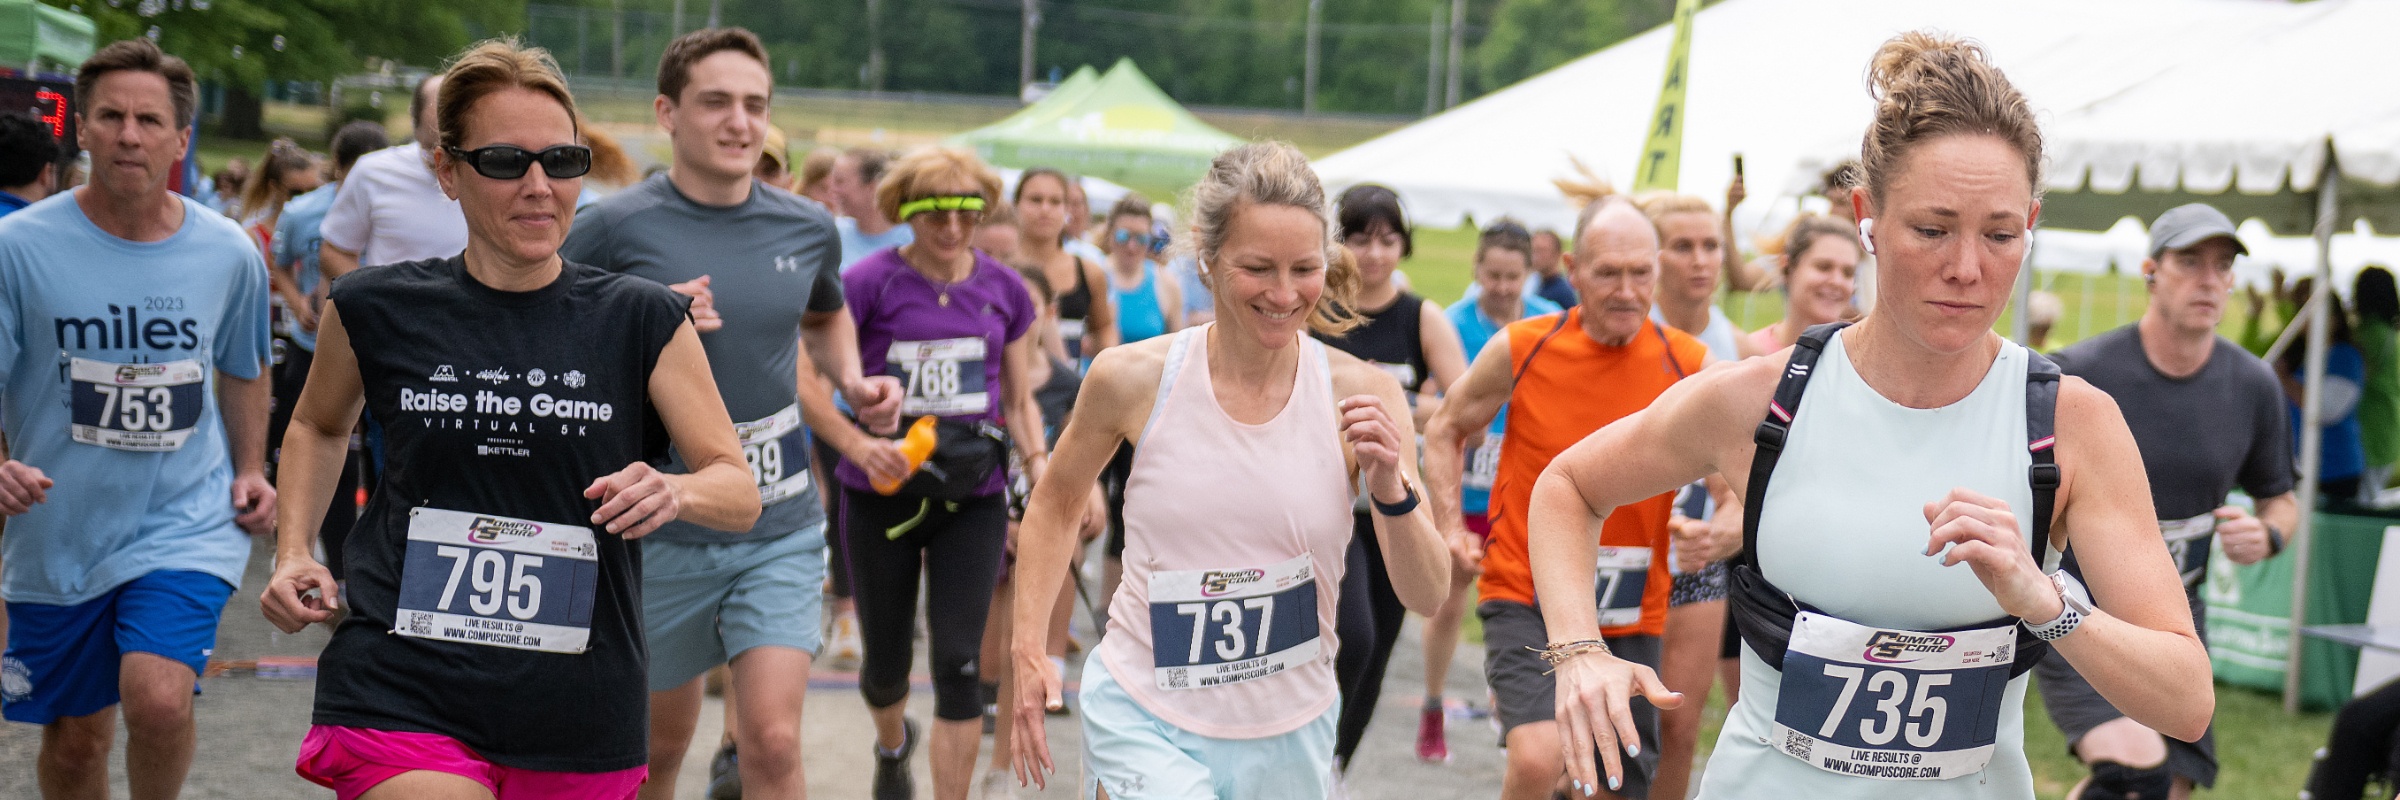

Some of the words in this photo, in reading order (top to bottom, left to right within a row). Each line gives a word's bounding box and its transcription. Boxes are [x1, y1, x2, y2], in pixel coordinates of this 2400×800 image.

[144, 296, 184, 311] 2023
[54, 303, 198, 350] miles
[901, 359, 960, 398] 768
[94, 383, 173, 432] 753
[400, 387, 468, 413] Raise
[475, 389, 522, 416] the
[530, 392, 613, 422] Game
[423, 417, 536, 434] VIRTUAL
[488, 446, 530, 458] KETTLER
[436, 544, 544, 620] 795
[464, 618, 481, 628] LIVE
[481, 619, 514, 632] RESULTS
[1177, 595, 1273, 664] 737
[443, 627, 542, 647] WWW.COMPUSCORE.COM
[1866, 630, 1945, 647] COMPU
[1873, 642, 1949, 659] SCORE
[1199, 662, 1285, 686] WWW.COMPUSCORE.COM
[1216, 664, 1231, 674] LIVE
[1231, 660, 1260, 672] RESULTS
[1817, 663, 1953, 748] 735
[1823, 756, 1942, 779] WWW.COMPUSCORE.COM
[1850, 749, 1871, 762] LIVE
[1871, 751, 1910, 764] RESULTS
[1911, 753, 1922, 765] @
